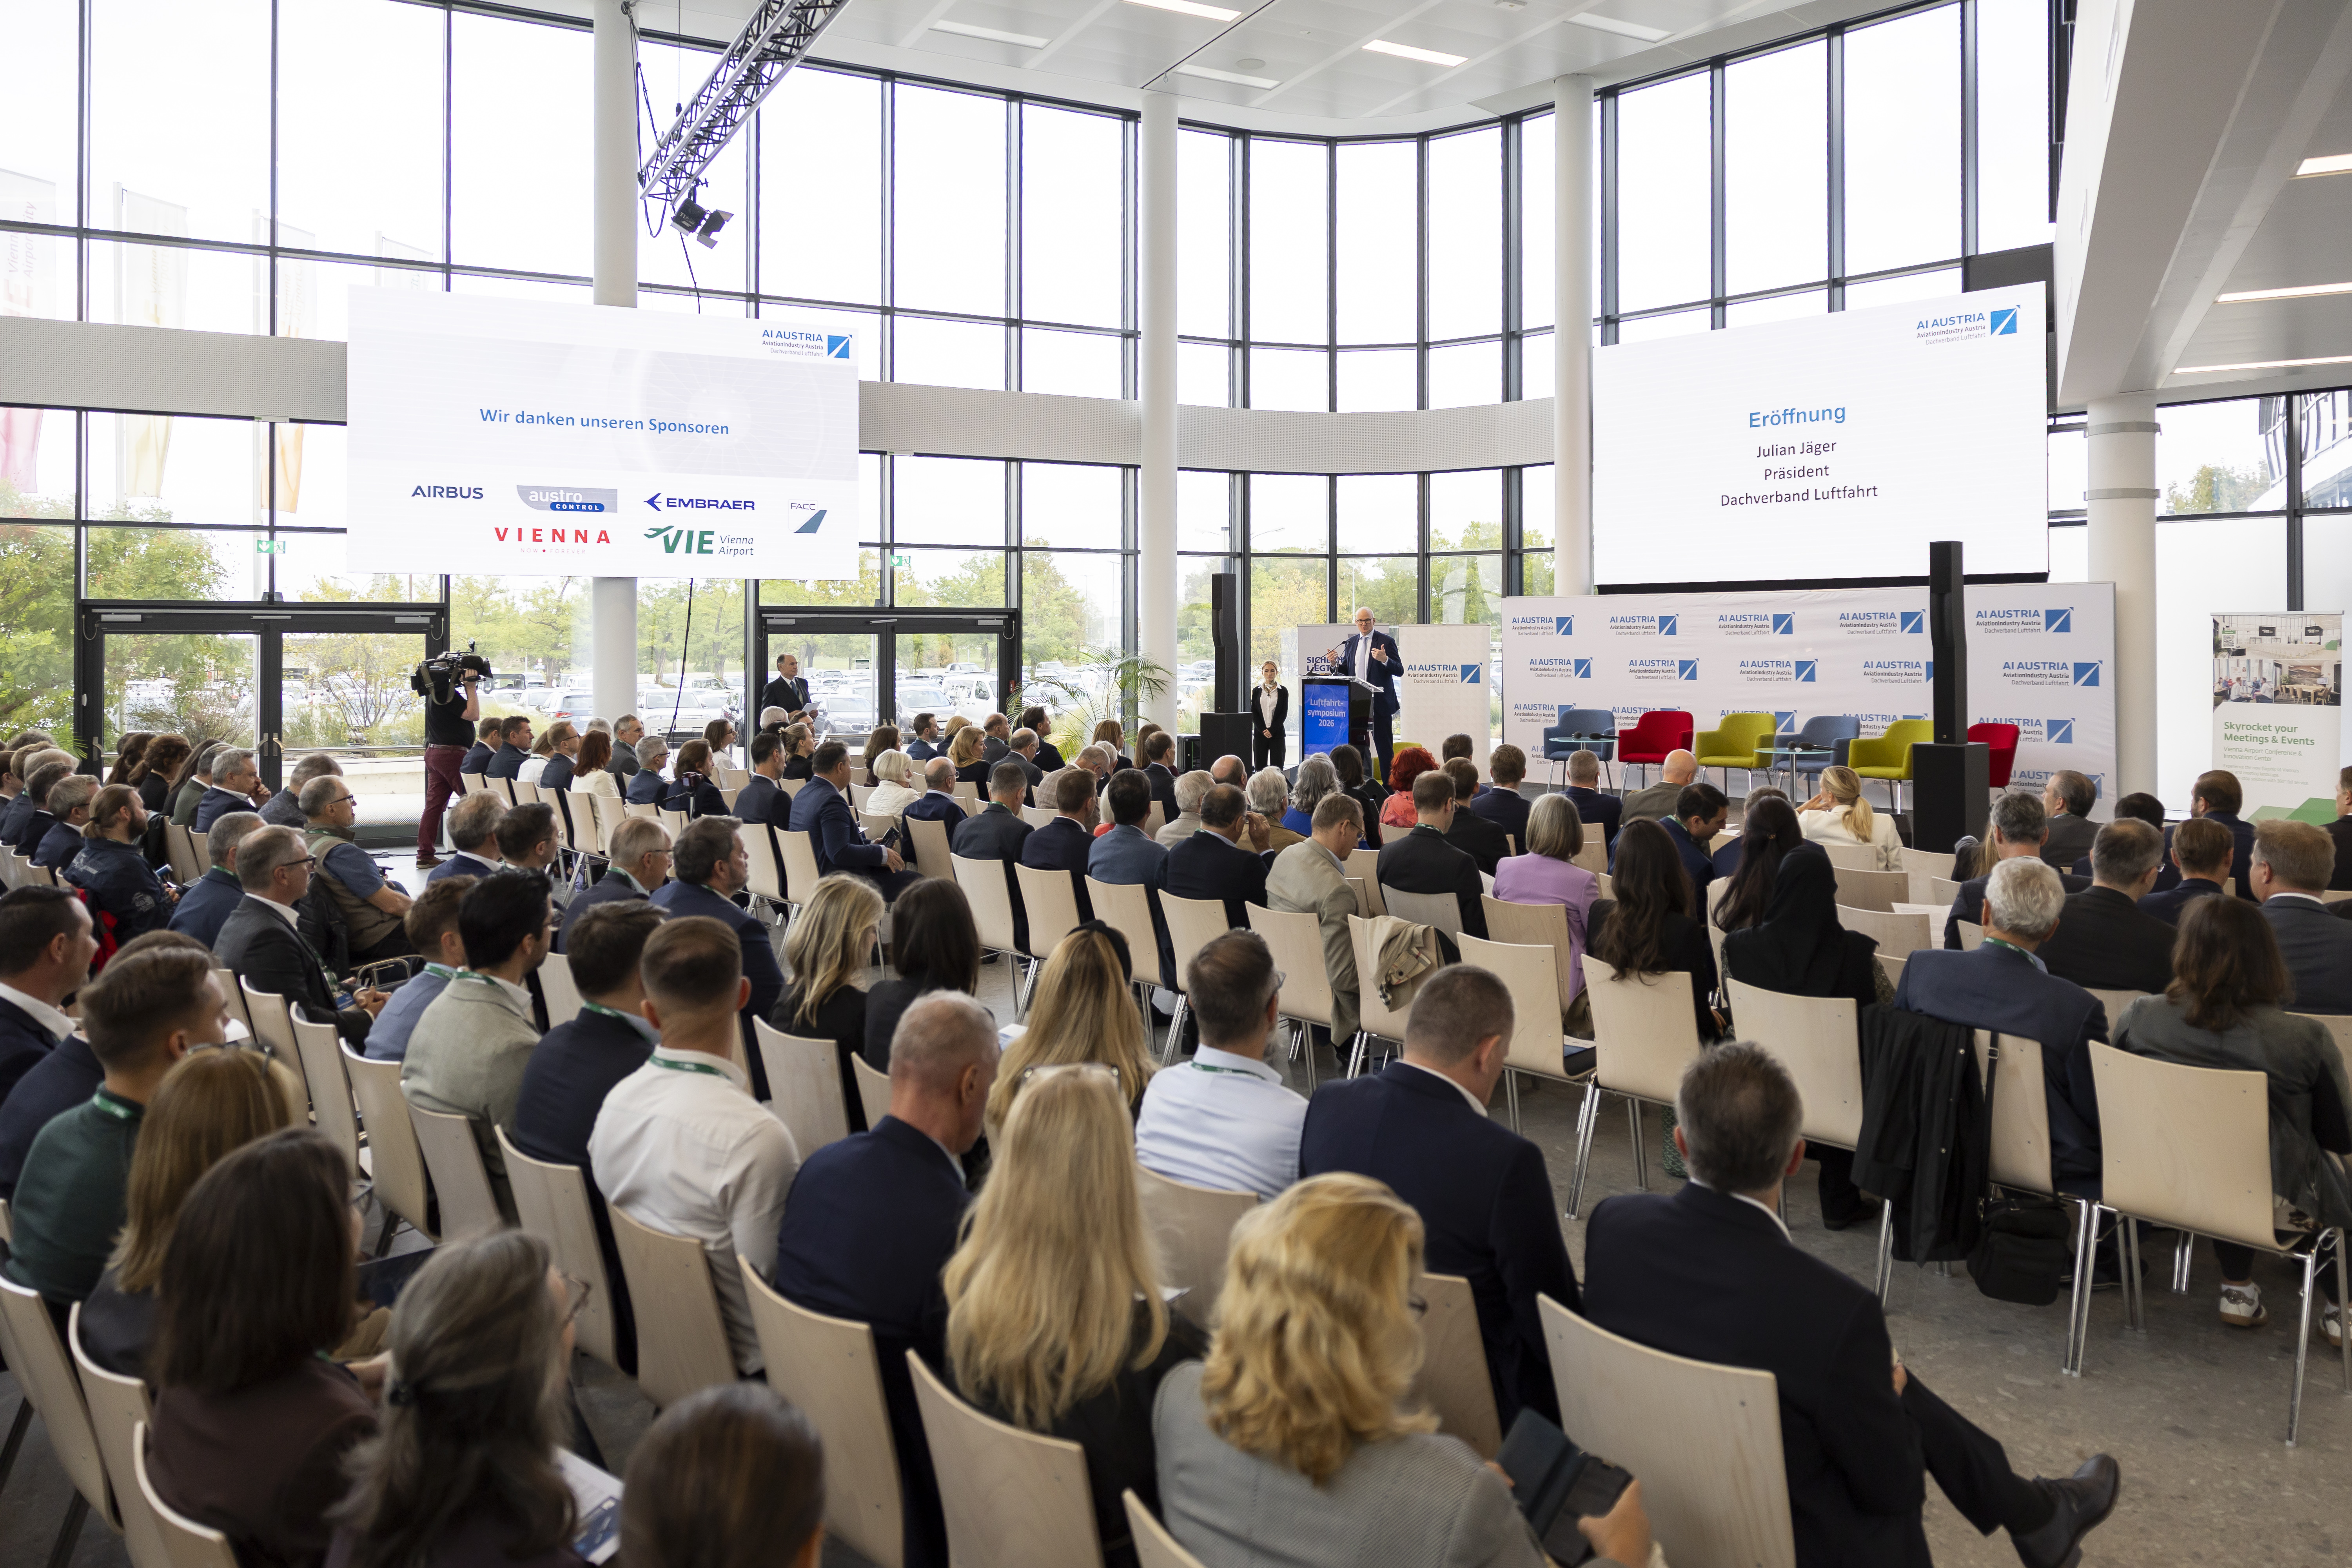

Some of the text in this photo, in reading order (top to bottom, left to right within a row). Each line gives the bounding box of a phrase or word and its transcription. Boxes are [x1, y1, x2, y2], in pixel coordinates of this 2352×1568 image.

[1916, 313, 1985, 330] AI AUSTRIA
[776, 331, 823, 342] AUSTRIA
[1917, 328, 1964, 338] AviationIndustry
[762, 341, 804, 349] AviationIndustry
[1926, 336, 1960, 345] Dachverband
[480, 409, 728, 434] Wir danken unseren Sponsoren
[1750, 407, 1845, 428] Eröffnung
[1757, 441, 1837, 457] Julian Jäger
[1765, 465, 1829, 480] Präsident
[411, 485, 483, 499] AIRBUS
[529, 489, 583, 503] austro
[1721, 485, 1878, 506] Dachverband Luftfahrt
[666, 498, 755, 510] EMBRAER
[494, 527, 610, 544] VIENNA
[720, 535, 753, 544] Vienna
[663, 530, 715, 554] VIE
[718, 546, 754, 557] Airport
[1989, 610, 2040, 618] AUSTRIA
[2017, 662, 2069, 670] AUSTRIA
[1310, 698, 1343, 707] Luftfahrt-
[1307, 709, 1346, 718] symposium
[2224, 722, 2298, 734] Skyrocket your
[2224, 733, 2269, 745] Meetings
[2281, 736, 2315, 745] Events
